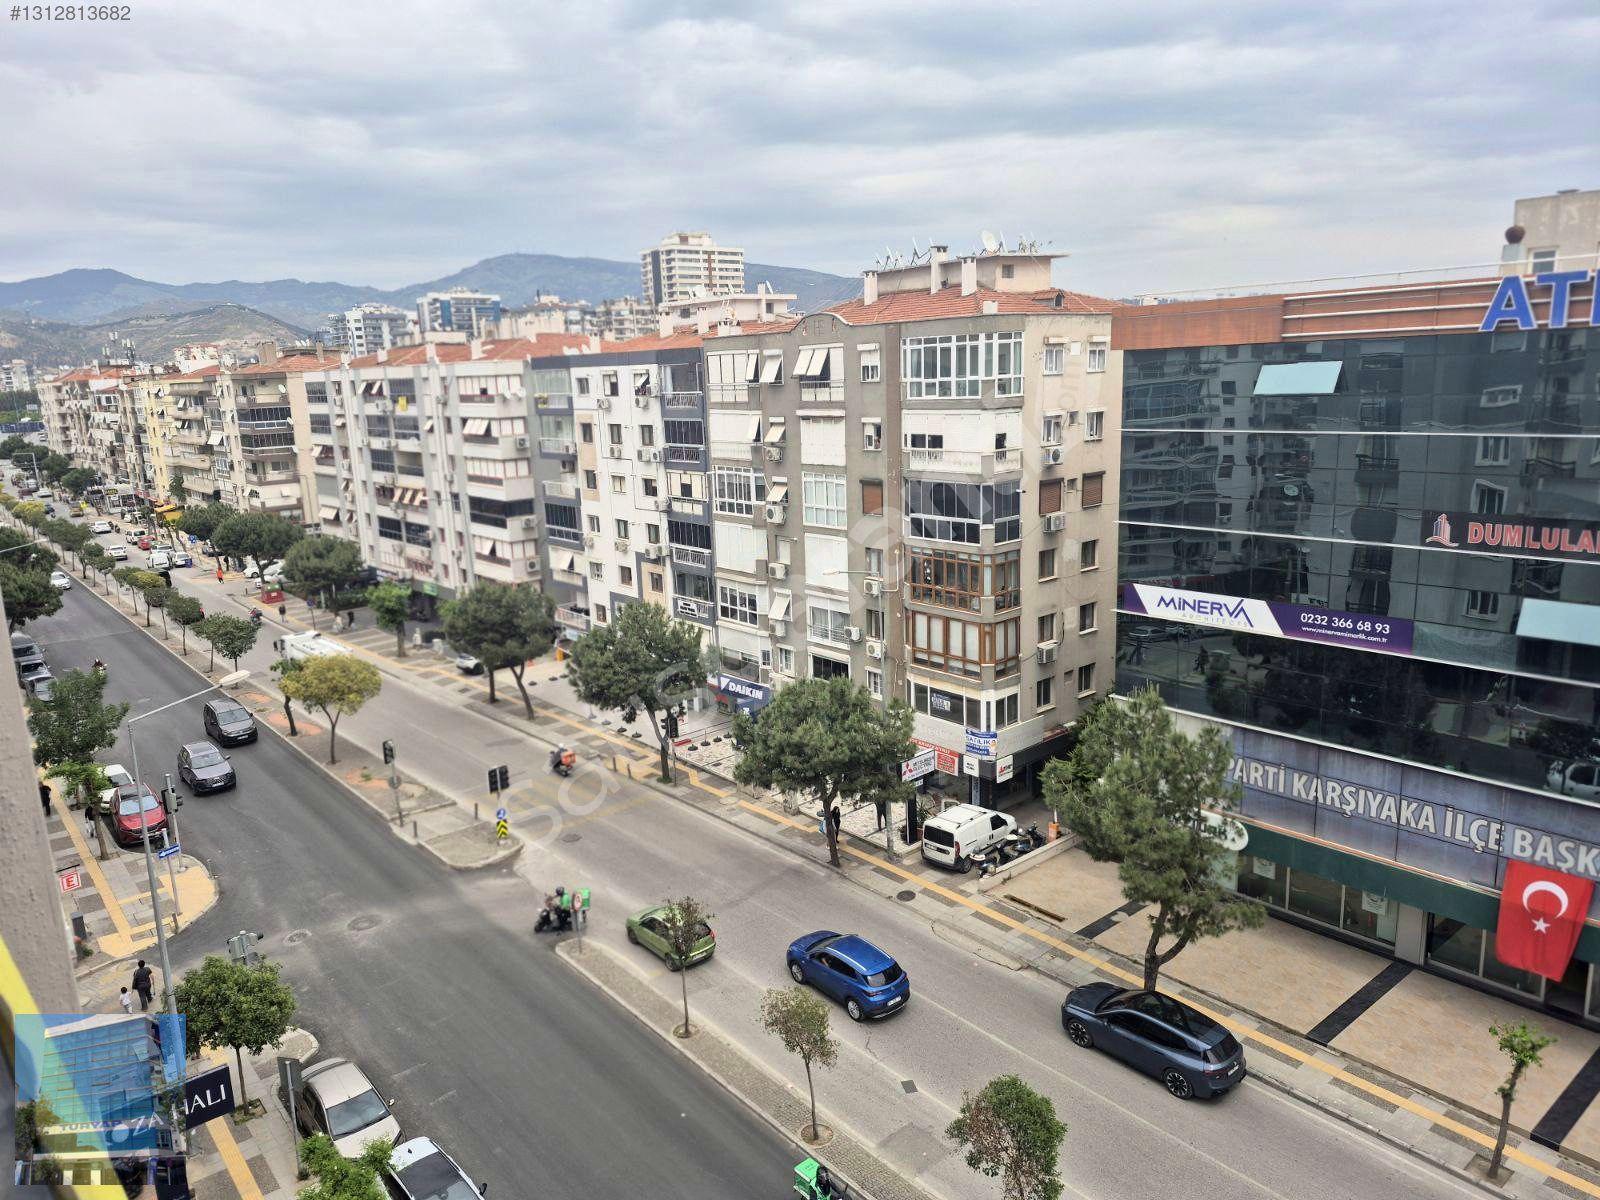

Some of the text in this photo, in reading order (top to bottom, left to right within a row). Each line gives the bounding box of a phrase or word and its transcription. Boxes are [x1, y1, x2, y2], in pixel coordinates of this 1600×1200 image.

[1300, 613, 1390, 634] 0232 366 68 93
[728, 681, 763, 700] DAIKIN
[1291, 772, 1436, 834] KARŞIYAKA
[1443, 806, 1505, 854] İLÇE
[1512, 827, 1600, 877] BAŞK
[65, 876, 76, 888] E
